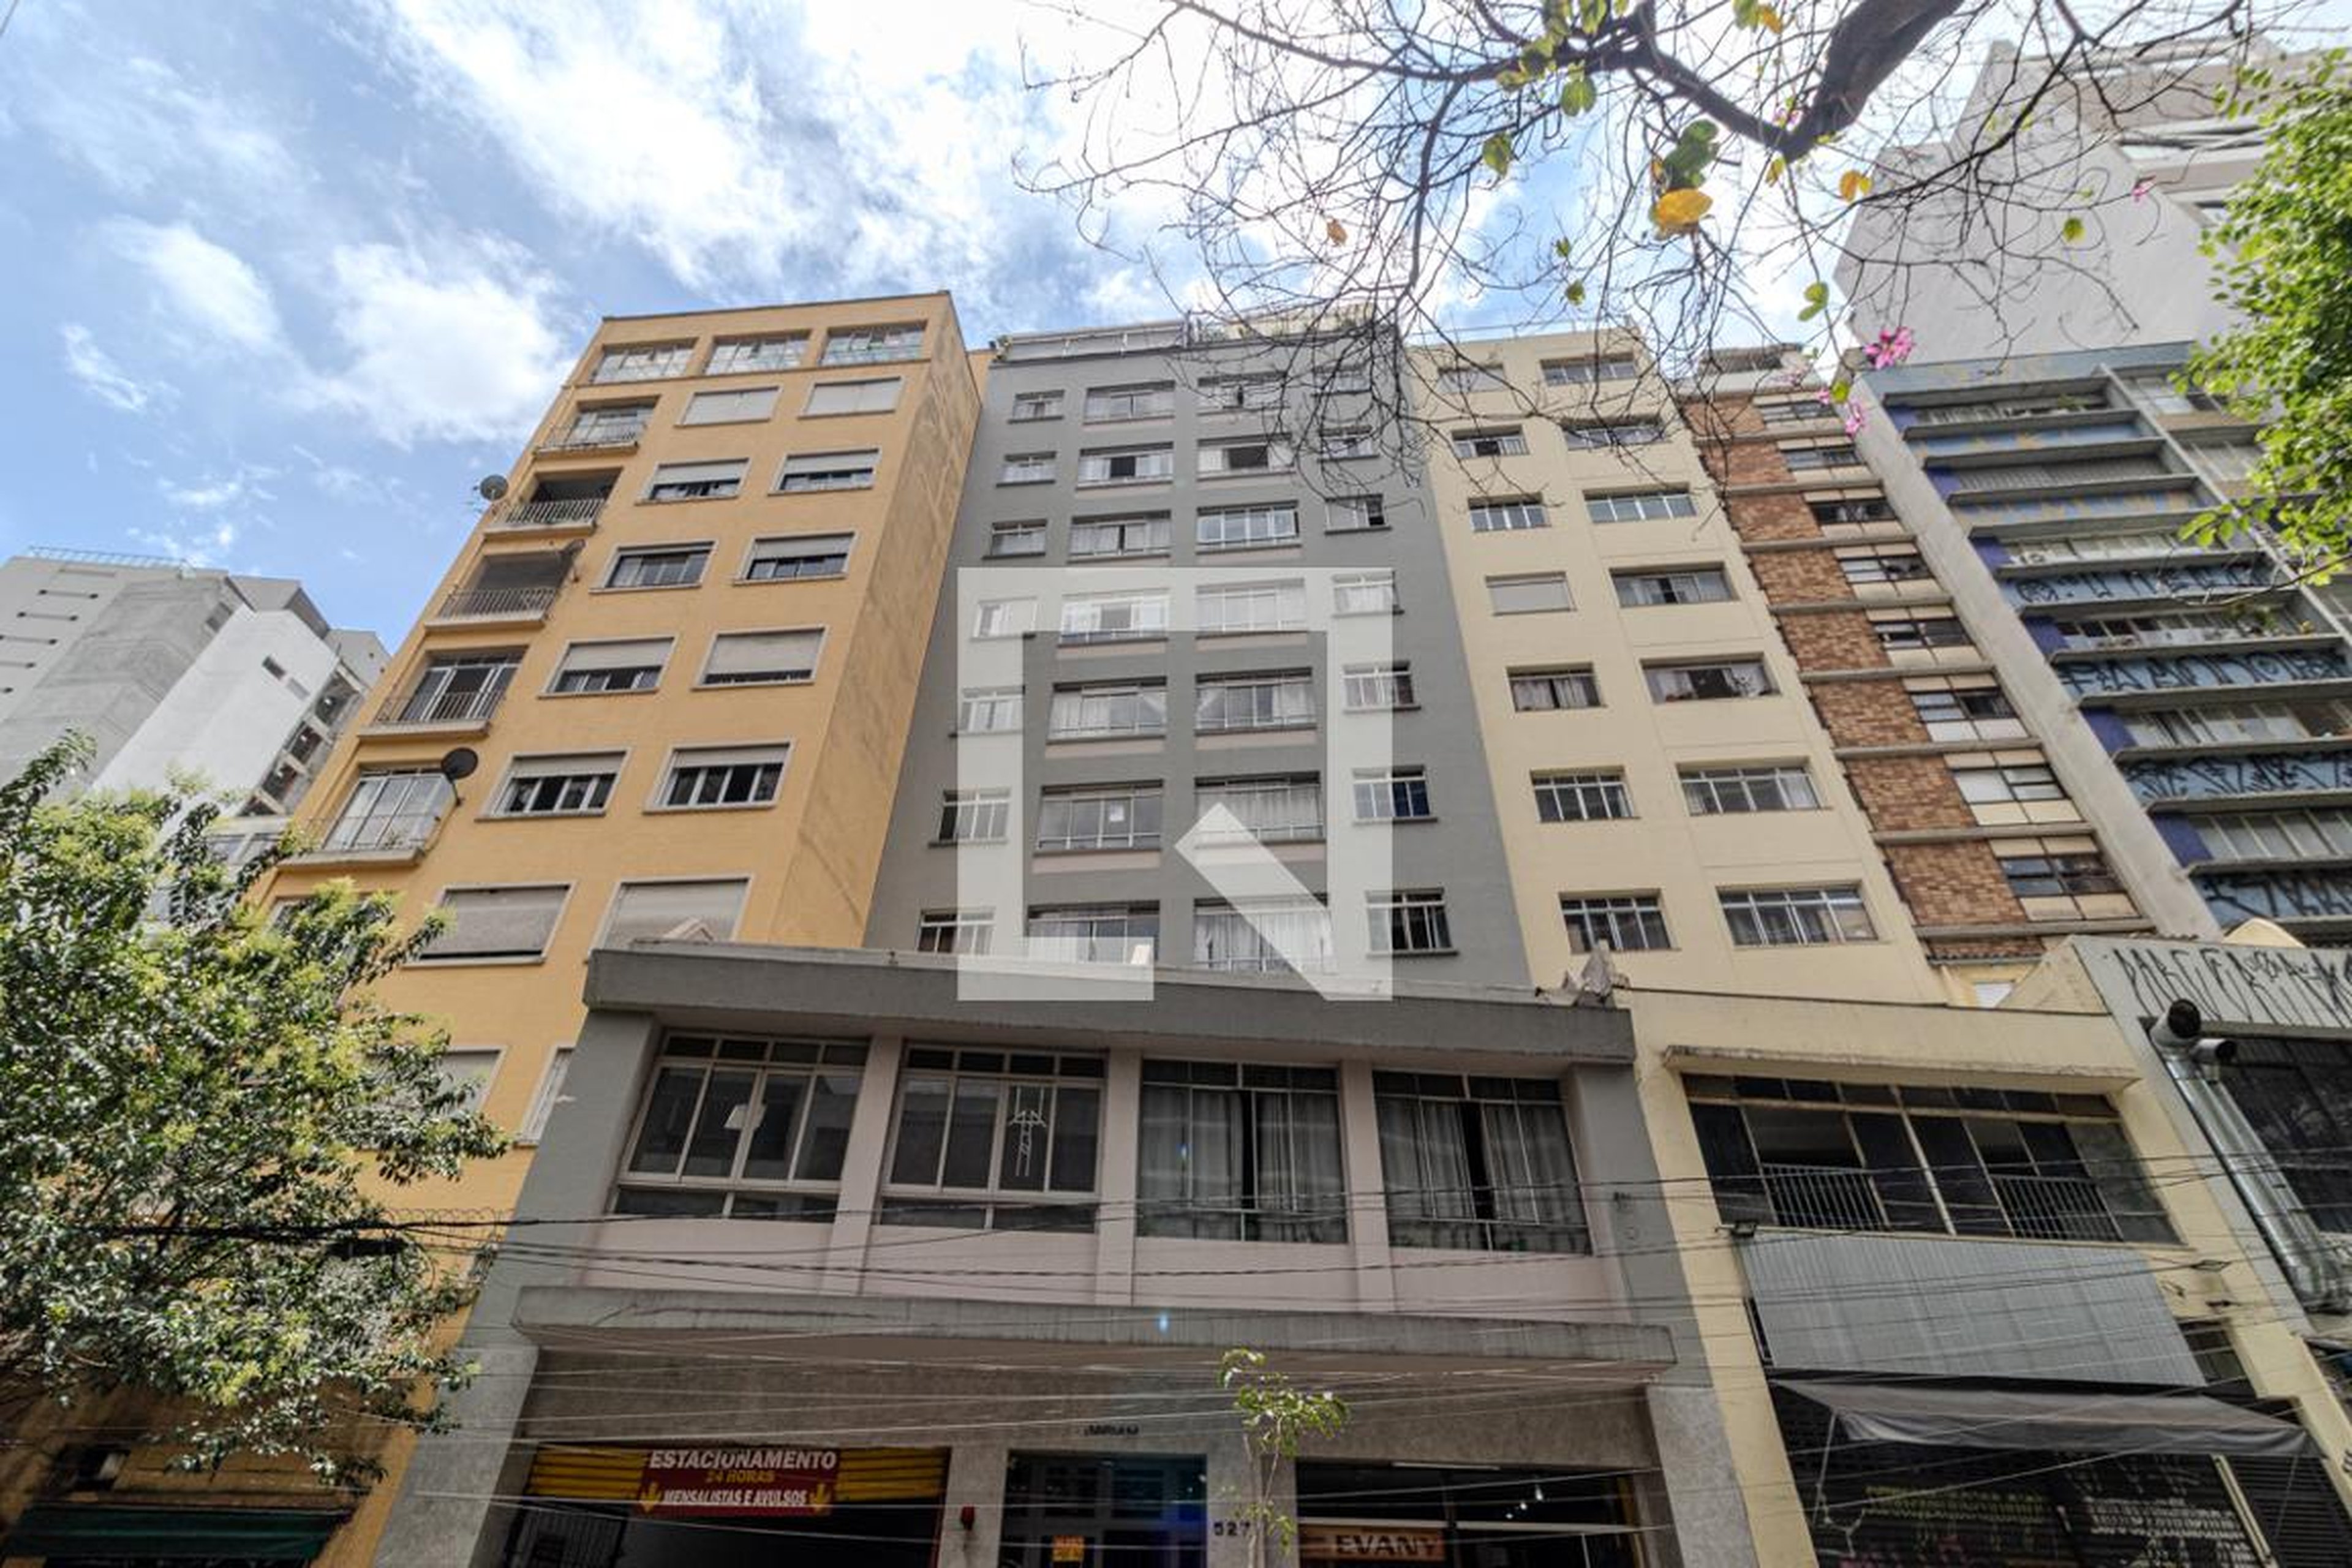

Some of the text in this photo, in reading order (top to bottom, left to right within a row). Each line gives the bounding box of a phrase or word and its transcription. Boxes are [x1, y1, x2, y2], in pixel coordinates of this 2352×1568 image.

[649, 1449, 837, 1469] ESTACIONAMENTO
[725, 1470, 776, 1483] HORAS
[663, 1489, 742, 1506] MENSALISTAS
[753, 1490, 808, 1506] AVULSOS
